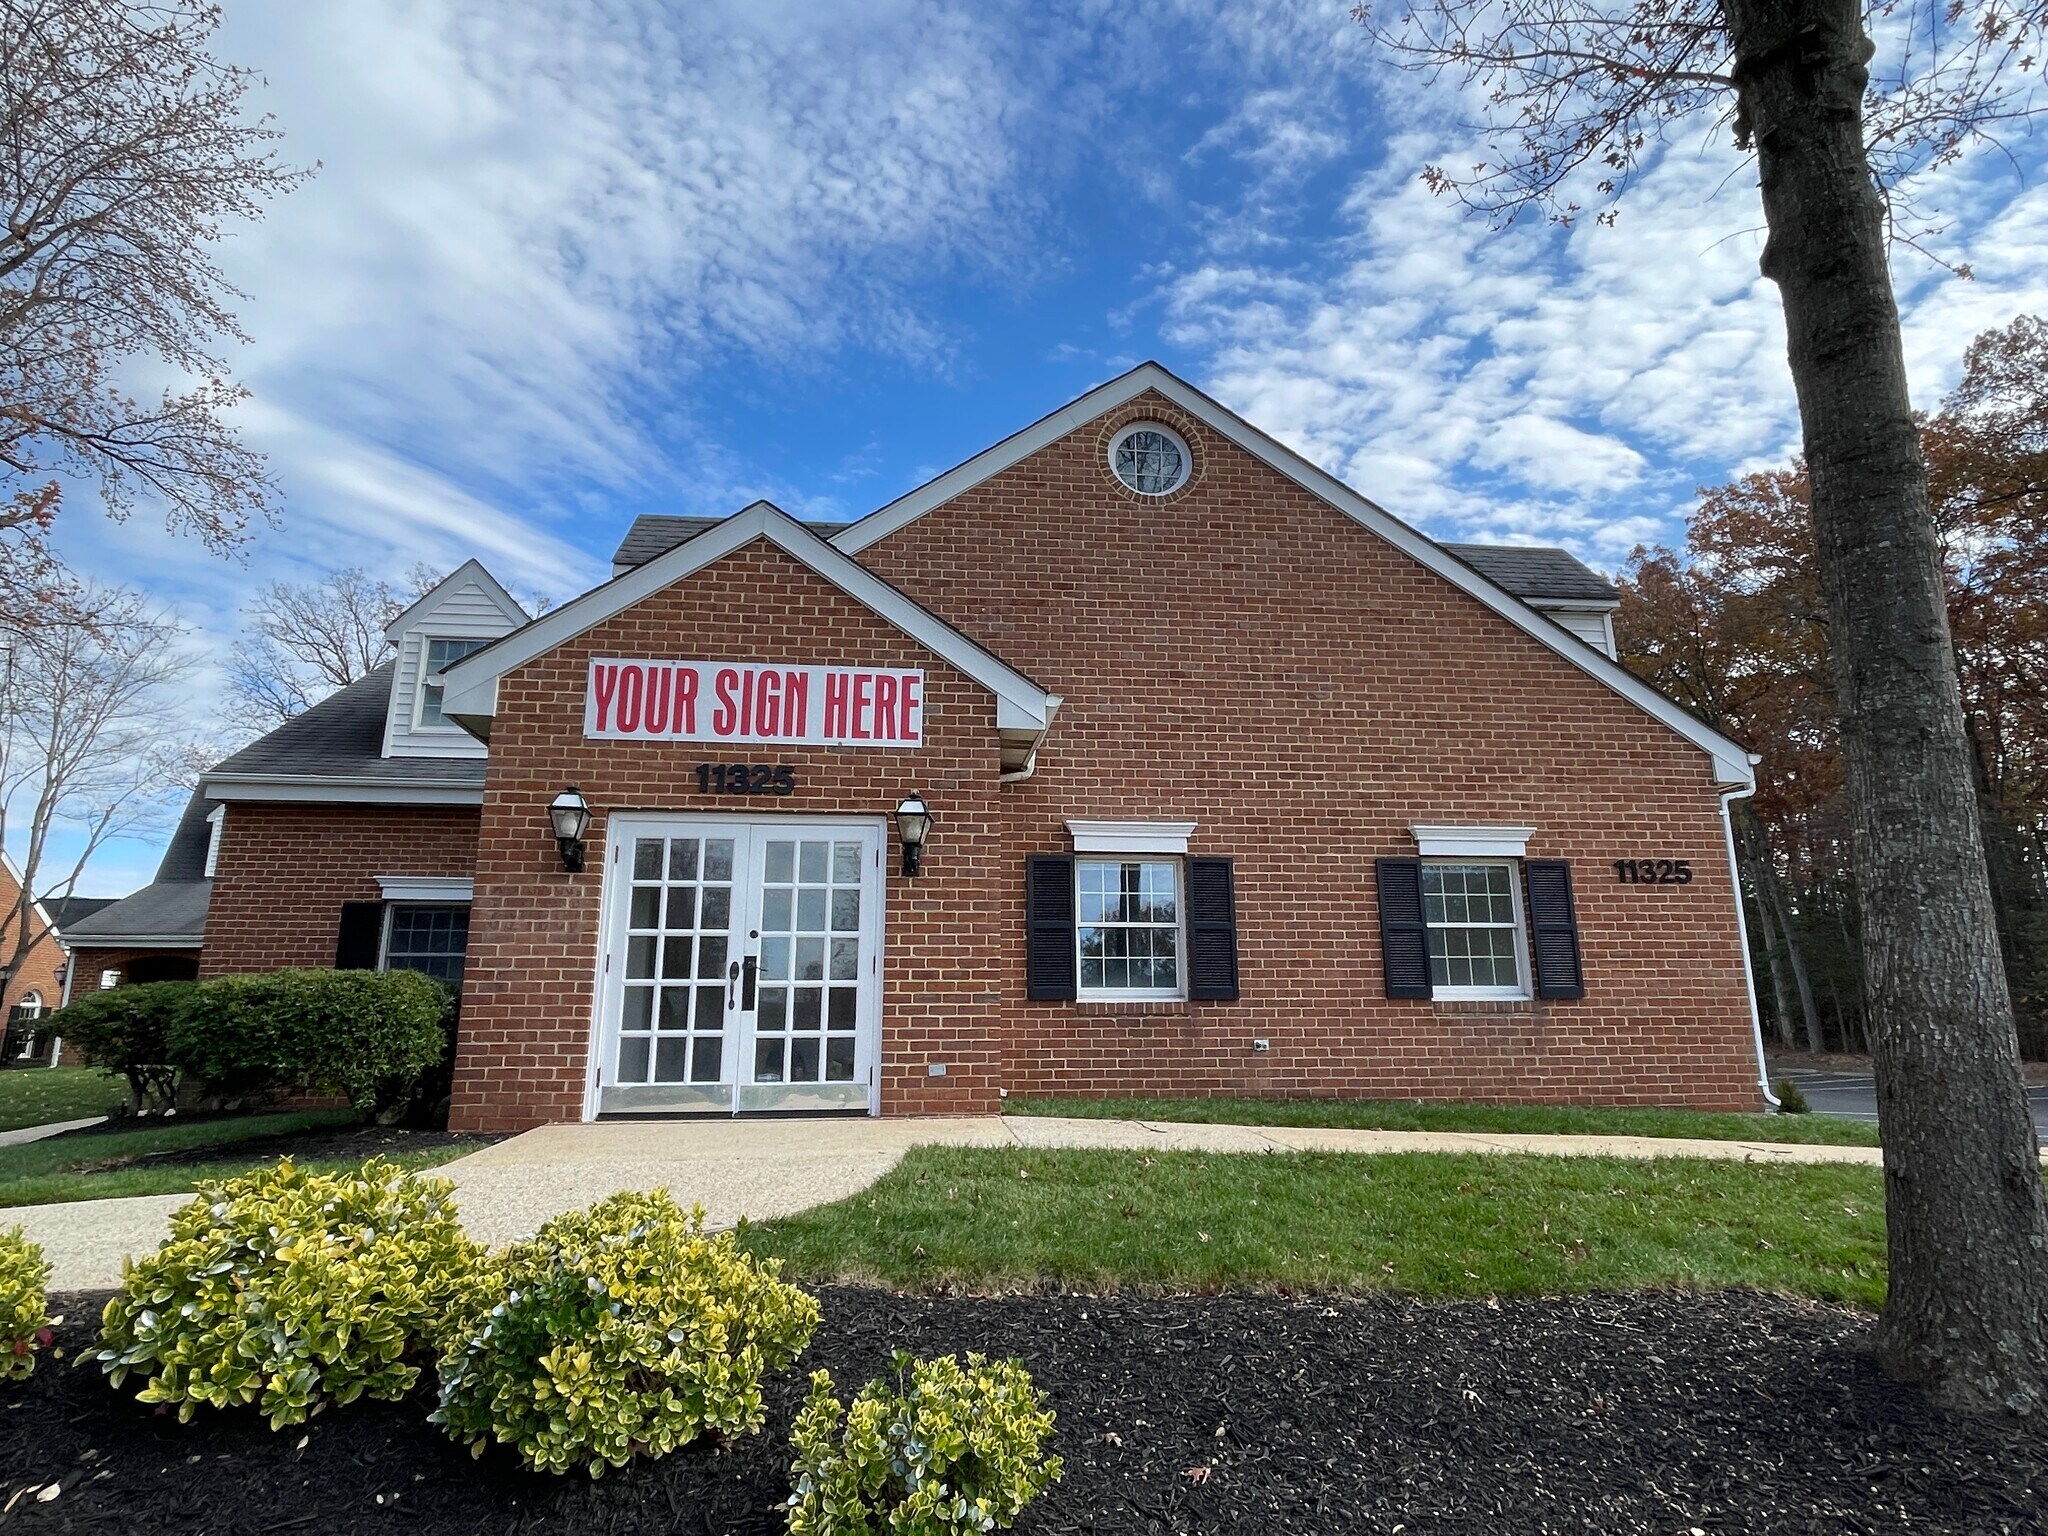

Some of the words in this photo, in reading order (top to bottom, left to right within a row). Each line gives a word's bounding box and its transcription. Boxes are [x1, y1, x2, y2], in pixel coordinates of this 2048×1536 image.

[594, 665, 700, 734] YOUR
[713, 668, 809, 737] SIGN
[824, 673, 921, 741] HERE
[696, 763, 796, 795] 11325
[1613, 859, 1693, 884] 11325
